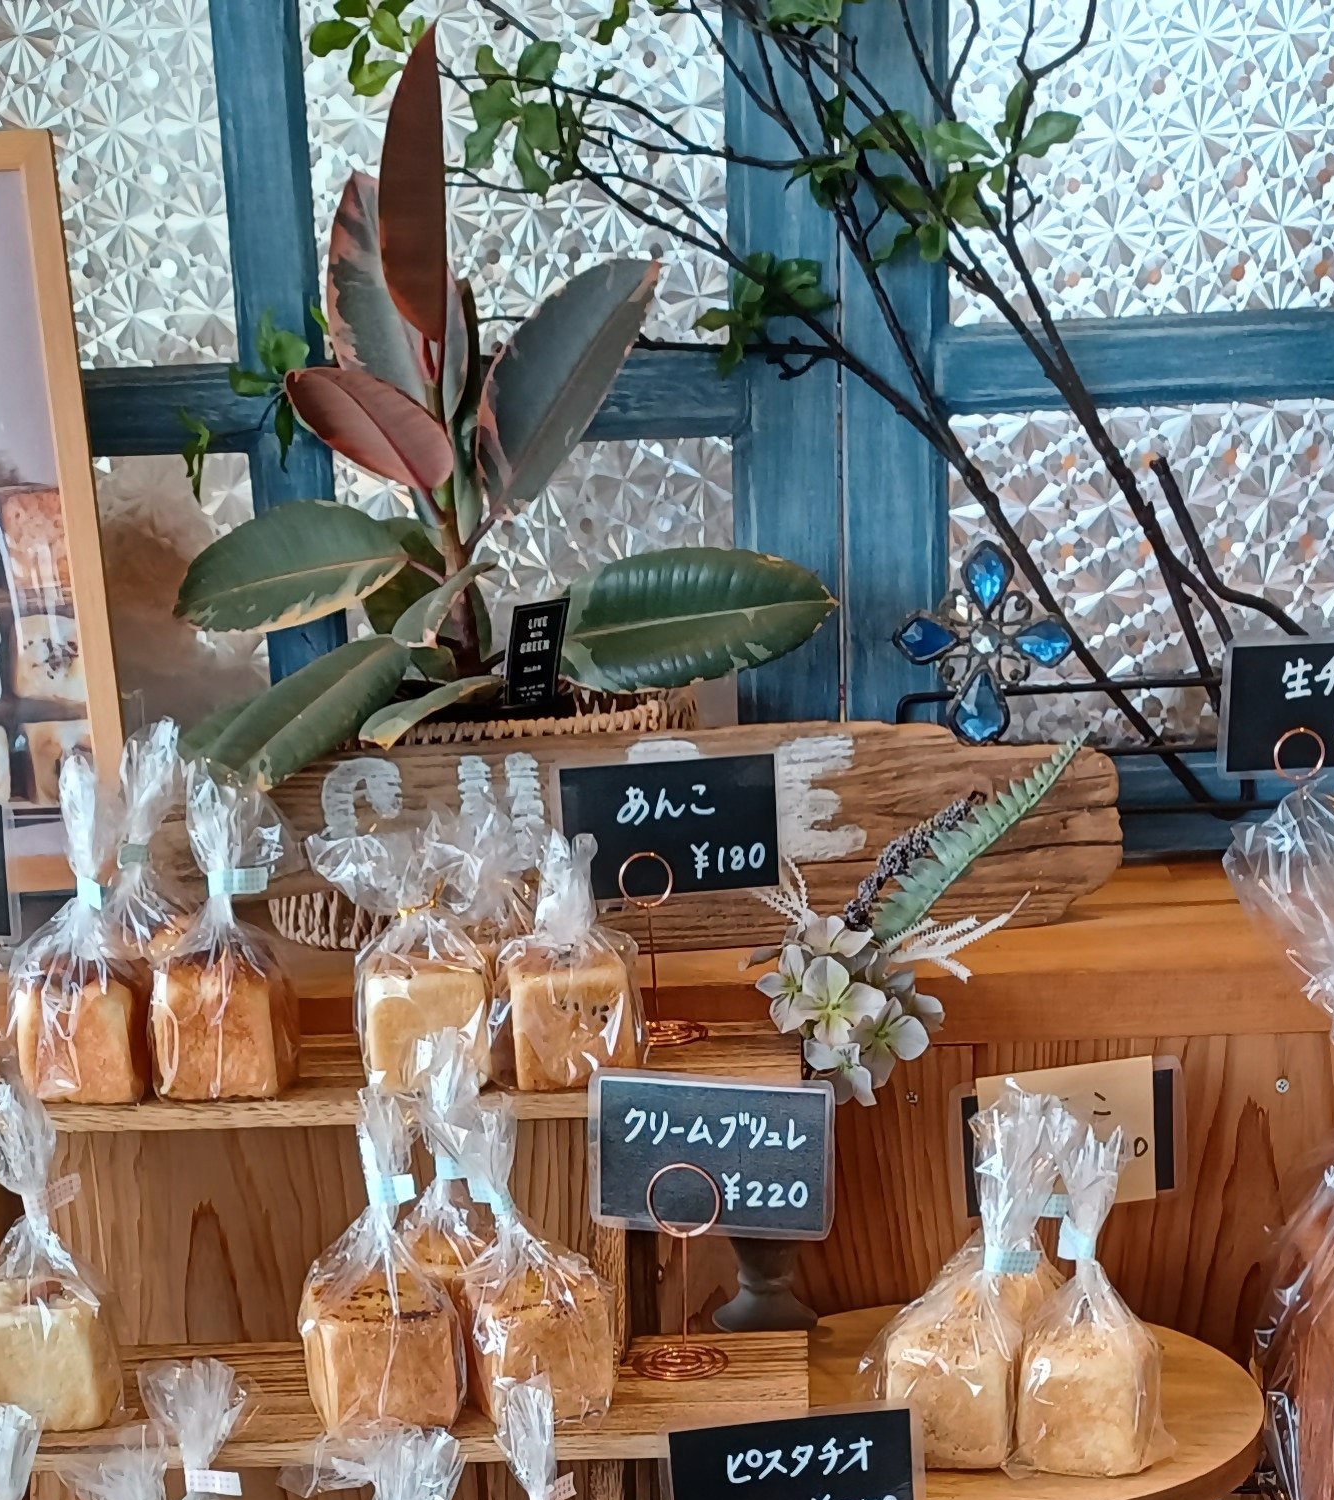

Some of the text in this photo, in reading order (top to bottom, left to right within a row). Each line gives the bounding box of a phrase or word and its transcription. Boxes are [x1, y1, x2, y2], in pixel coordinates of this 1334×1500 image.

[616, 783, 716, 826] あんこ
[689, 841, 767, 880] ¥180
[623, 1106, 808, 1151] クリームブリュレ
[721, 1171, 809, 1212] ¥220
[726, 1436, 874, 1485] ピスタチオ
